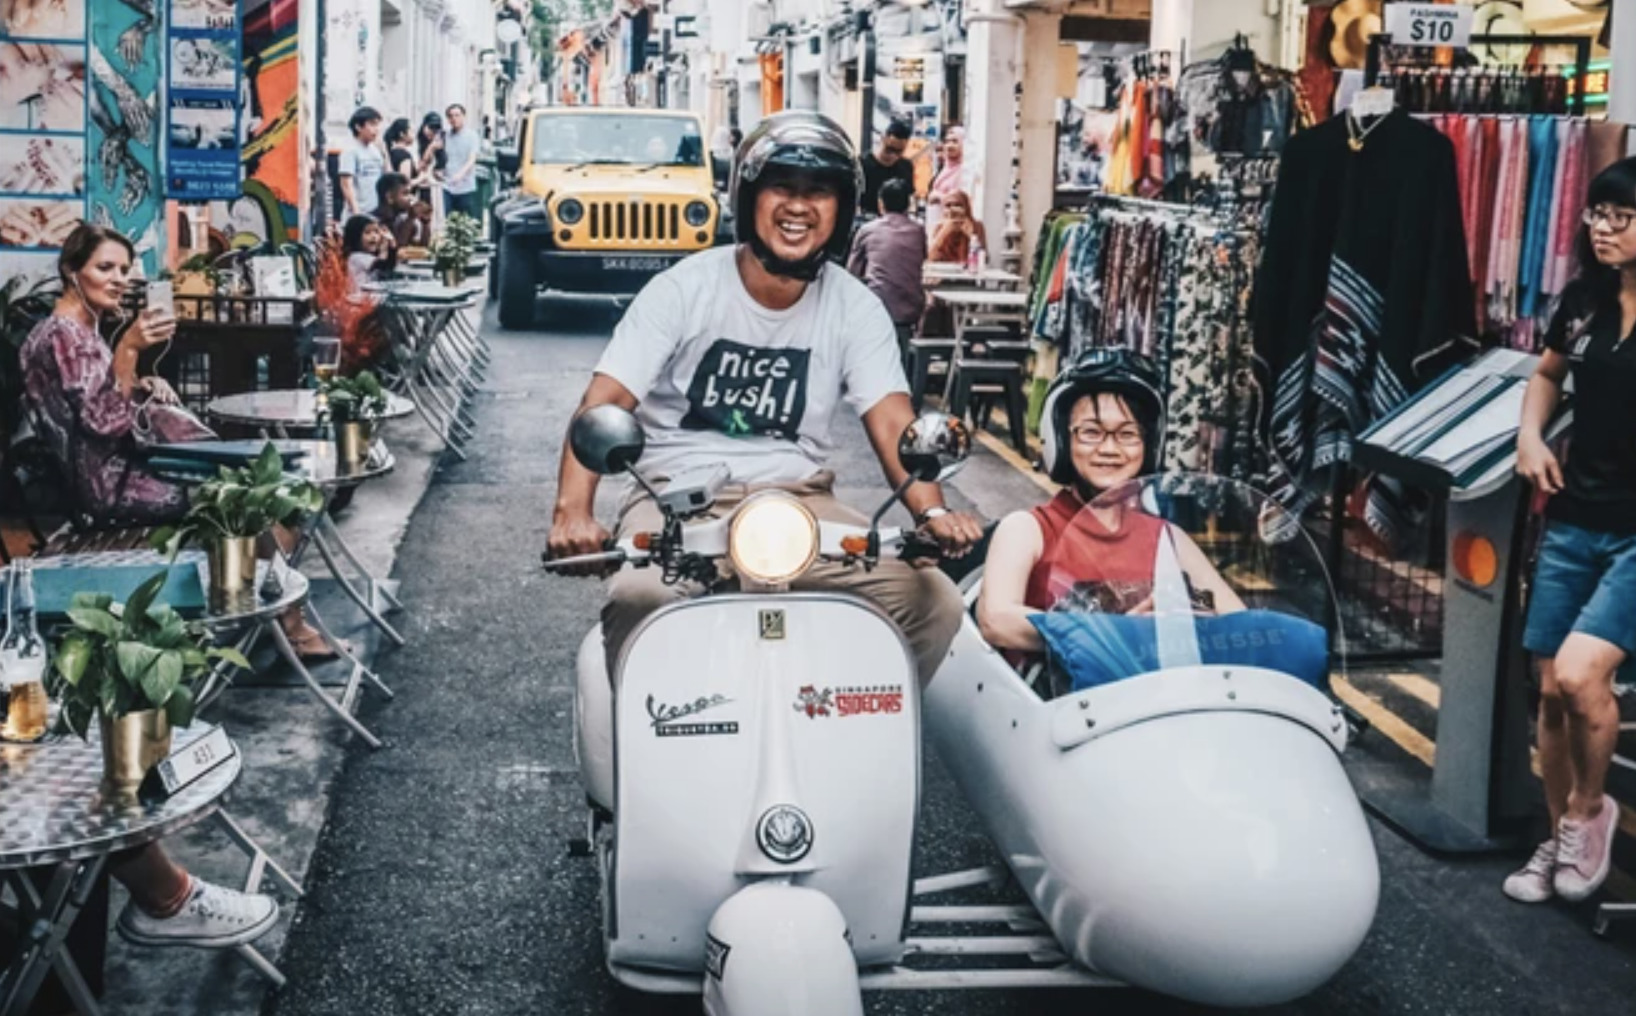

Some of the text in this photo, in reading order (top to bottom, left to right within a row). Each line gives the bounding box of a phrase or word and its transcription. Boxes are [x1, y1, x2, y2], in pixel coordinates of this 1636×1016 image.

[1409, 18, 1454, 42] $10
[717, 348, 791, 378] nice
[702, 374, 798, 424] bush!
[835, 683, 903, 693] SINGAPORE
[645, 693, 735, 727] Vespa
[835, 693, 904, 717] SIDECARS
